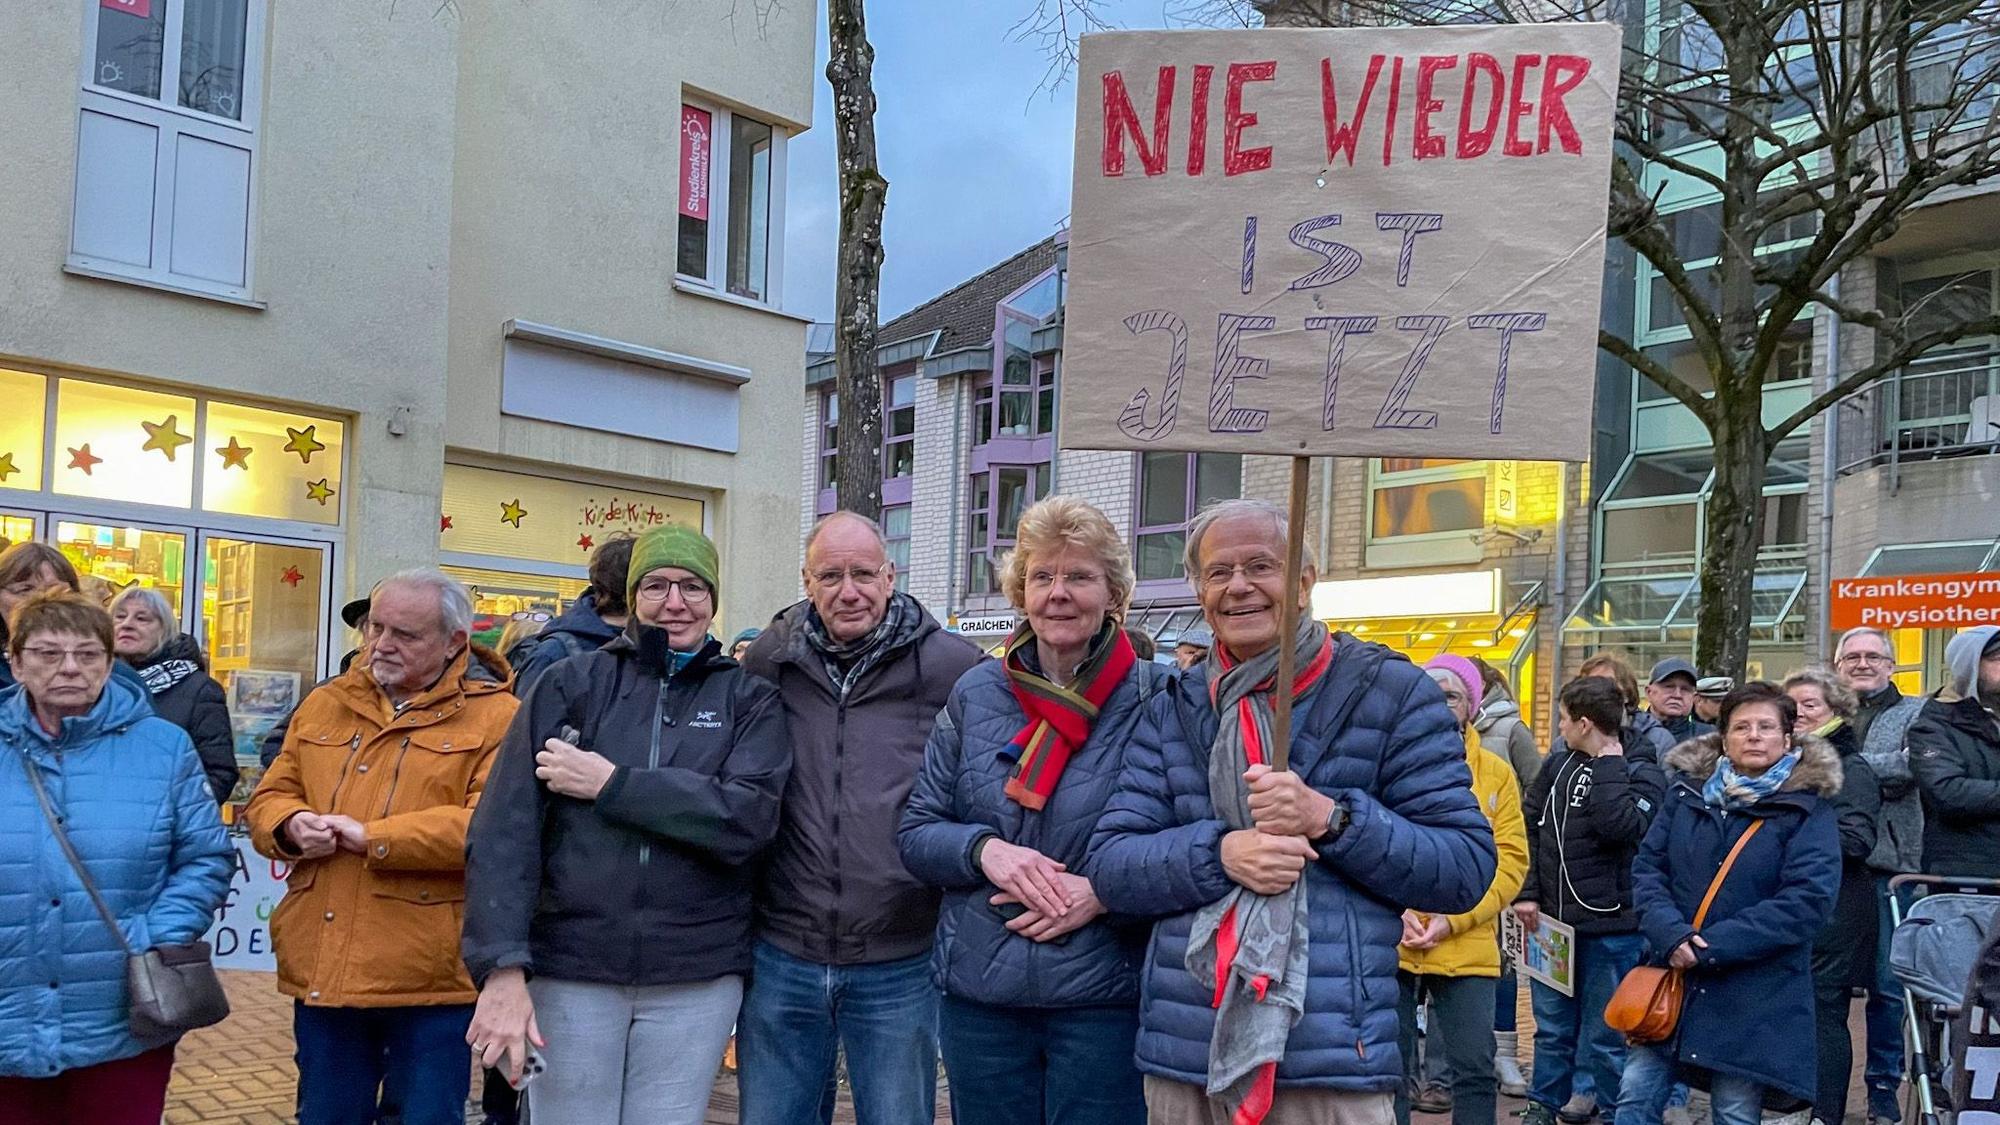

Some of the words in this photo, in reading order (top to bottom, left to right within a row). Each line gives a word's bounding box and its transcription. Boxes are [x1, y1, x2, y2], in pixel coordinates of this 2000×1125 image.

[1102, 61, 1277, 177] NIE
[1321, 54, 1591, 167] WIEDER
[687, 131, 702, 212] Studienkreis
[1241, 213, 1443, 295] IST
[1117, 309, 1547, 441] JETZT
[961, 620, 1013, 632] GRAICHEN
[1838, 579, 2000, 599] Krankengym
[1861, 604, 2000, 627] Physiother
